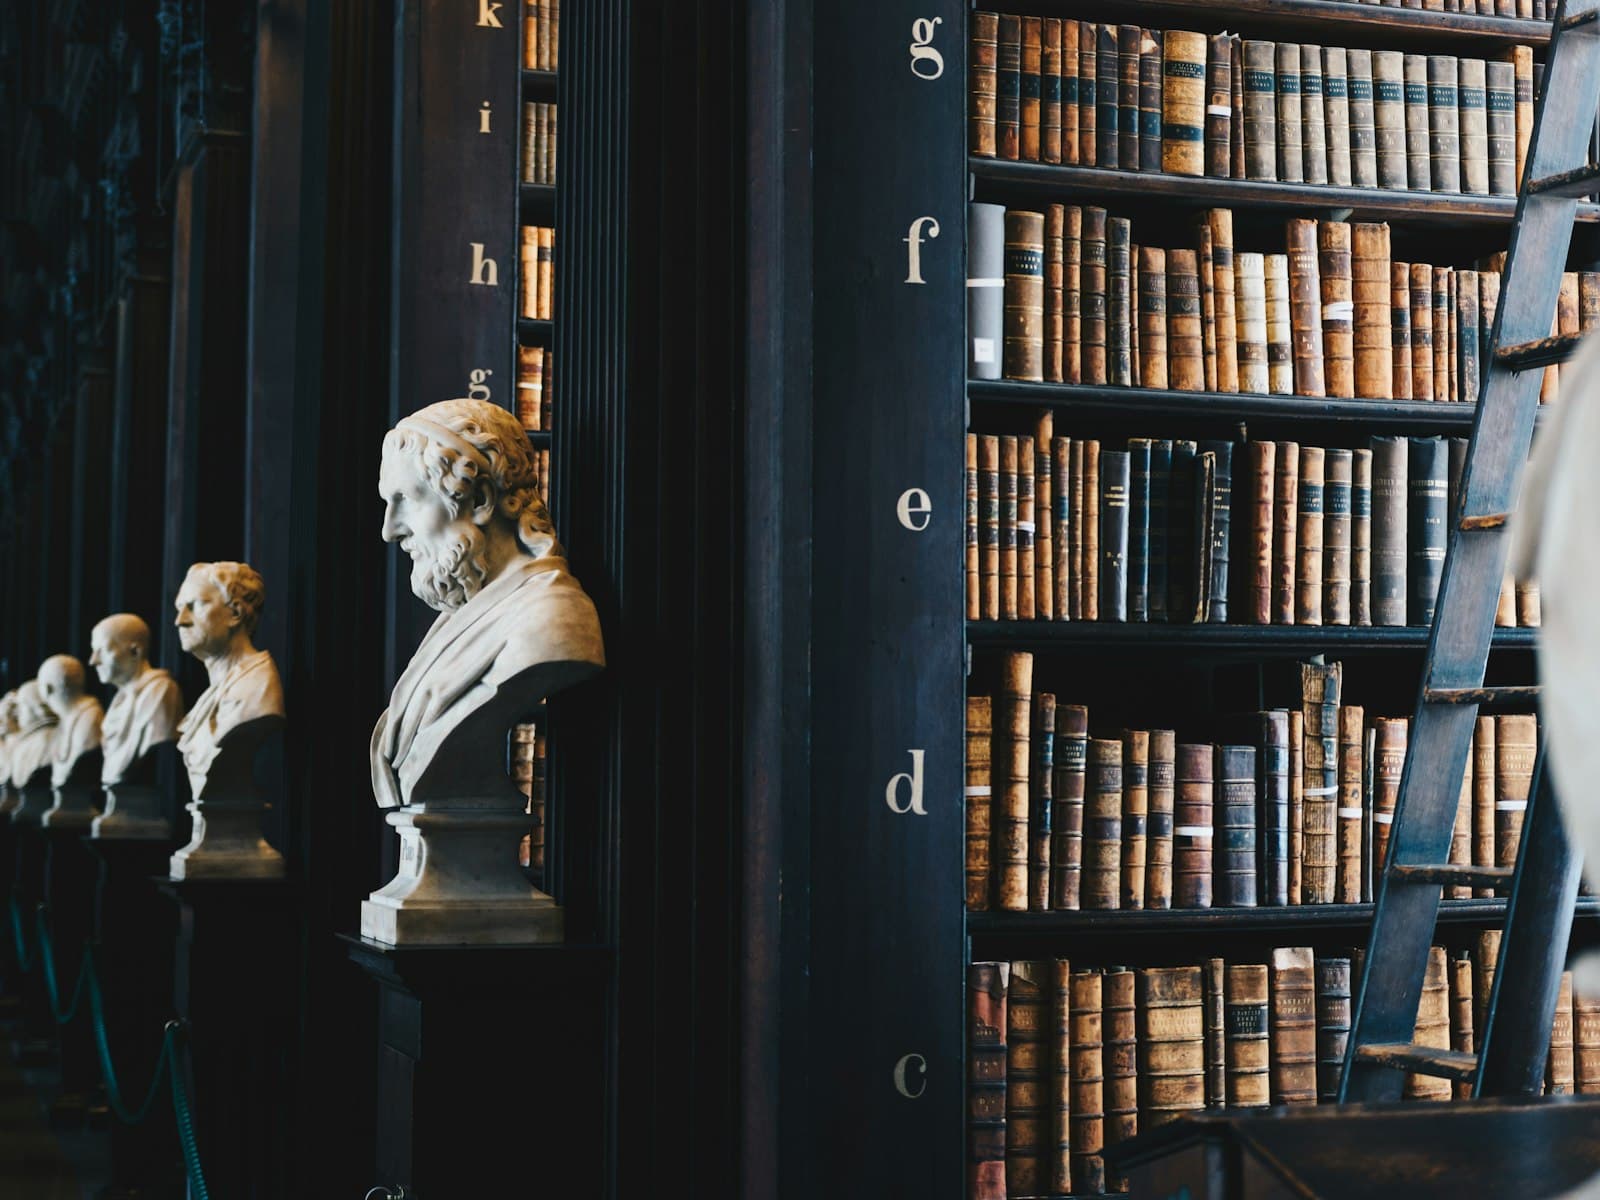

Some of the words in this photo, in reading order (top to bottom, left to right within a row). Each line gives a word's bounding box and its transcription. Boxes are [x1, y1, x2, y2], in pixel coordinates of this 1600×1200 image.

[476, 0, 503, 28] k
[909, 16, 943, 80] g
[480, 101, 492, 133] i
[469, 242, 498, 286] h
[902, 216, 940, 284] f
[469, 368, 492, 400] g
[896, 488, 932, 531] e
[886, 749, 928, 815] d
[893, 1053, 927, 1099] c
